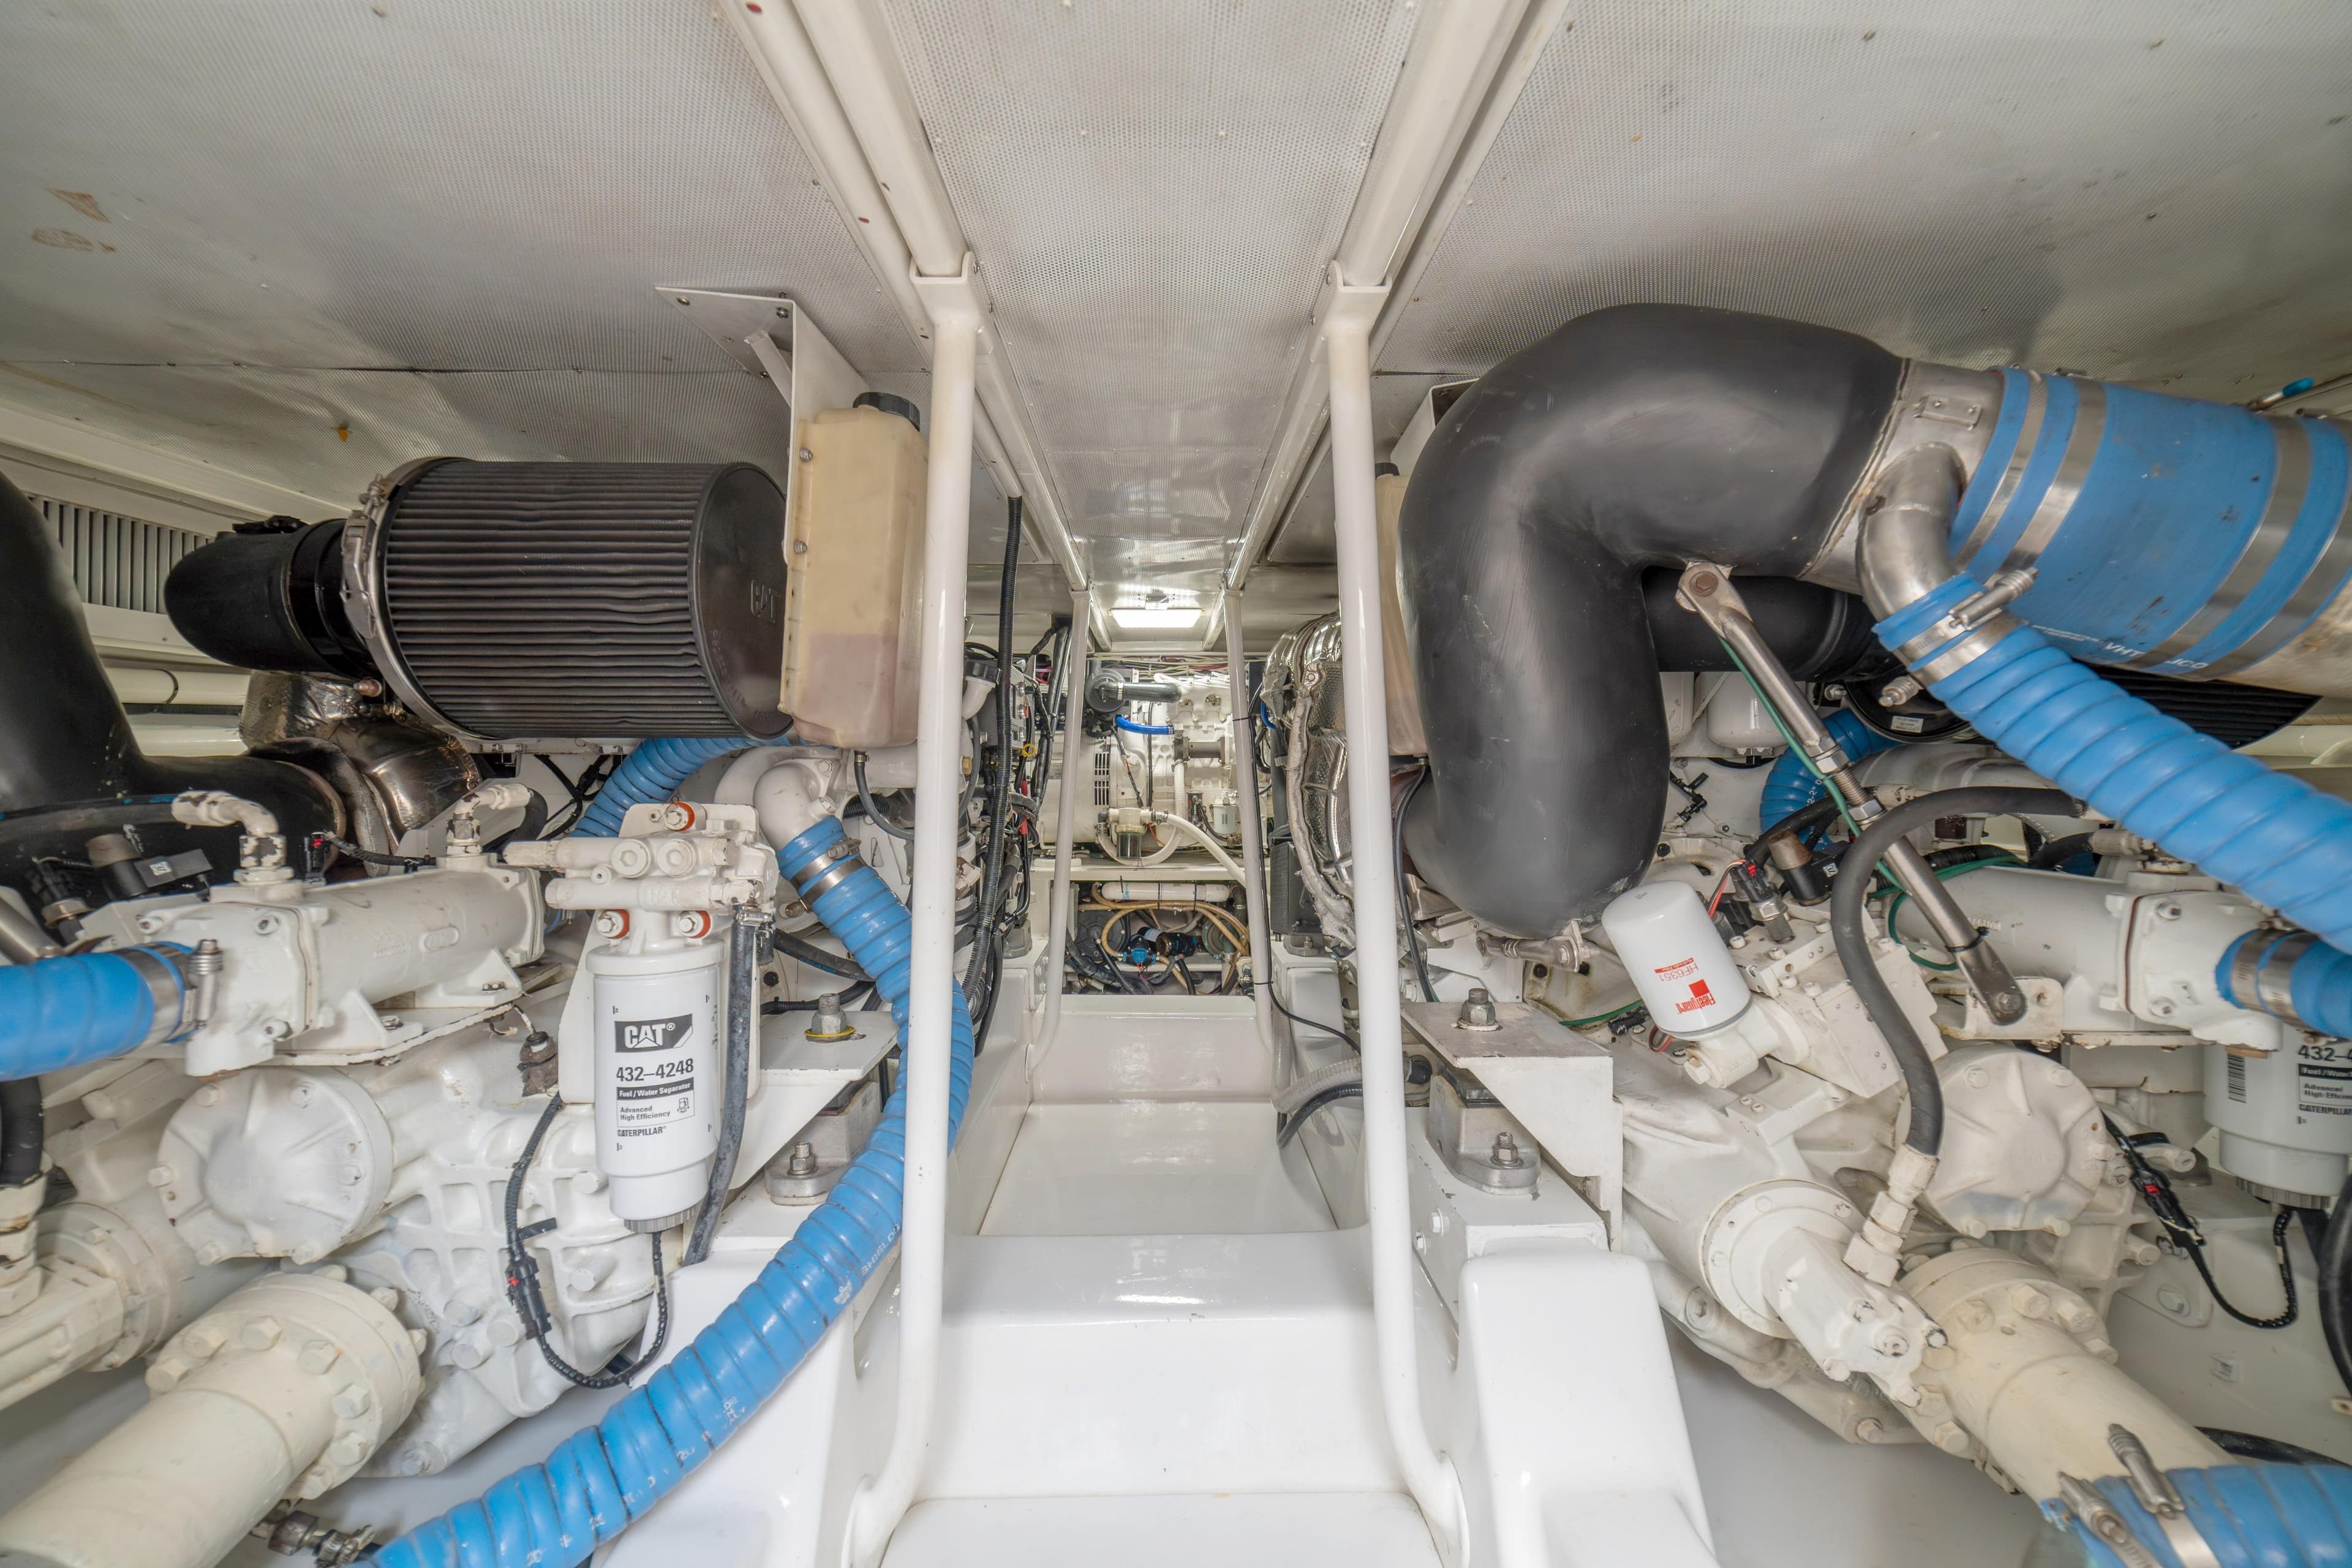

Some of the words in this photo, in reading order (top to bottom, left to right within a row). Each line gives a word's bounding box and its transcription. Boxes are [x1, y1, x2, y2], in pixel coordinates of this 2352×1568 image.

[1659, 963, 1698, 981] HF6351
[1675, 993, 1716, 1014] Fleetguard
[616, 1058, 693, 1081] 432-4248
[659, 1083, 691, 1094] Separator
[636, 1111, 670, 1120] Efficiency
